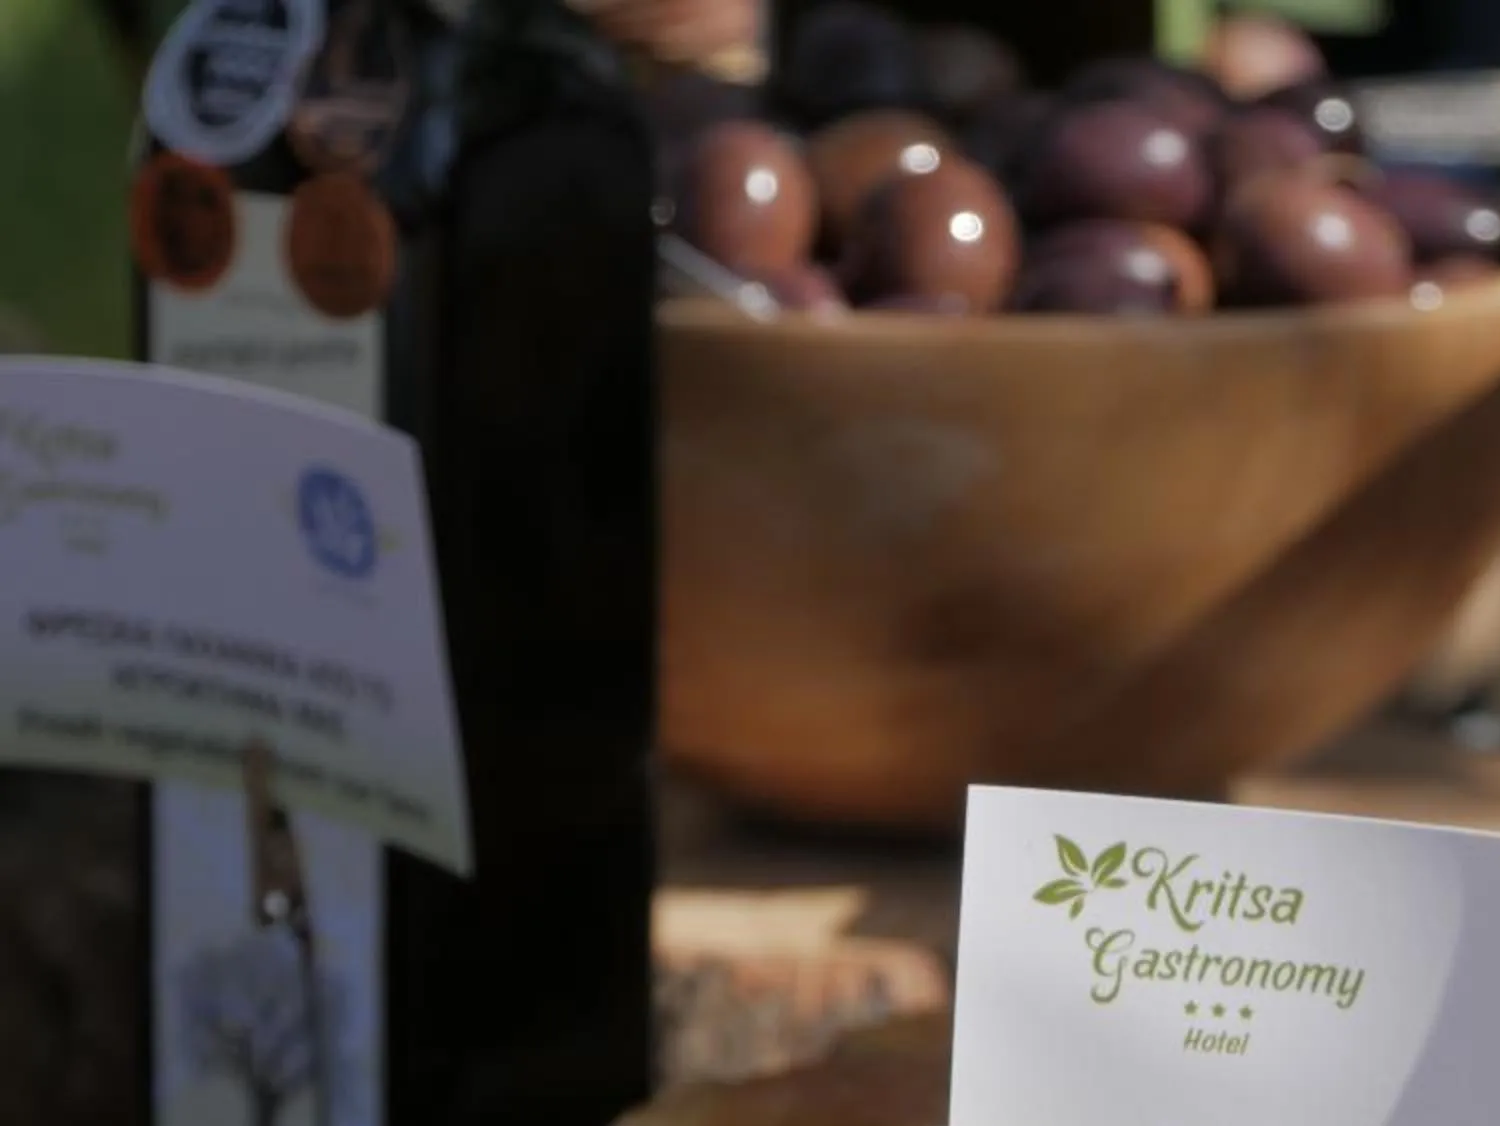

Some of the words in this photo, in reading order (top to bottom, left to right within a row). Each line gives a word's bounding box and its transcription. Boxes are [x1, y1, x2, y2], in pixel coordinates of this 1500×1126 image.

[1131, 846, 1304, 932] Kritsa
[1085, 927, 1365, 1009] Gastronomy
[1183, 1028, 1252, 1056] Hotel
